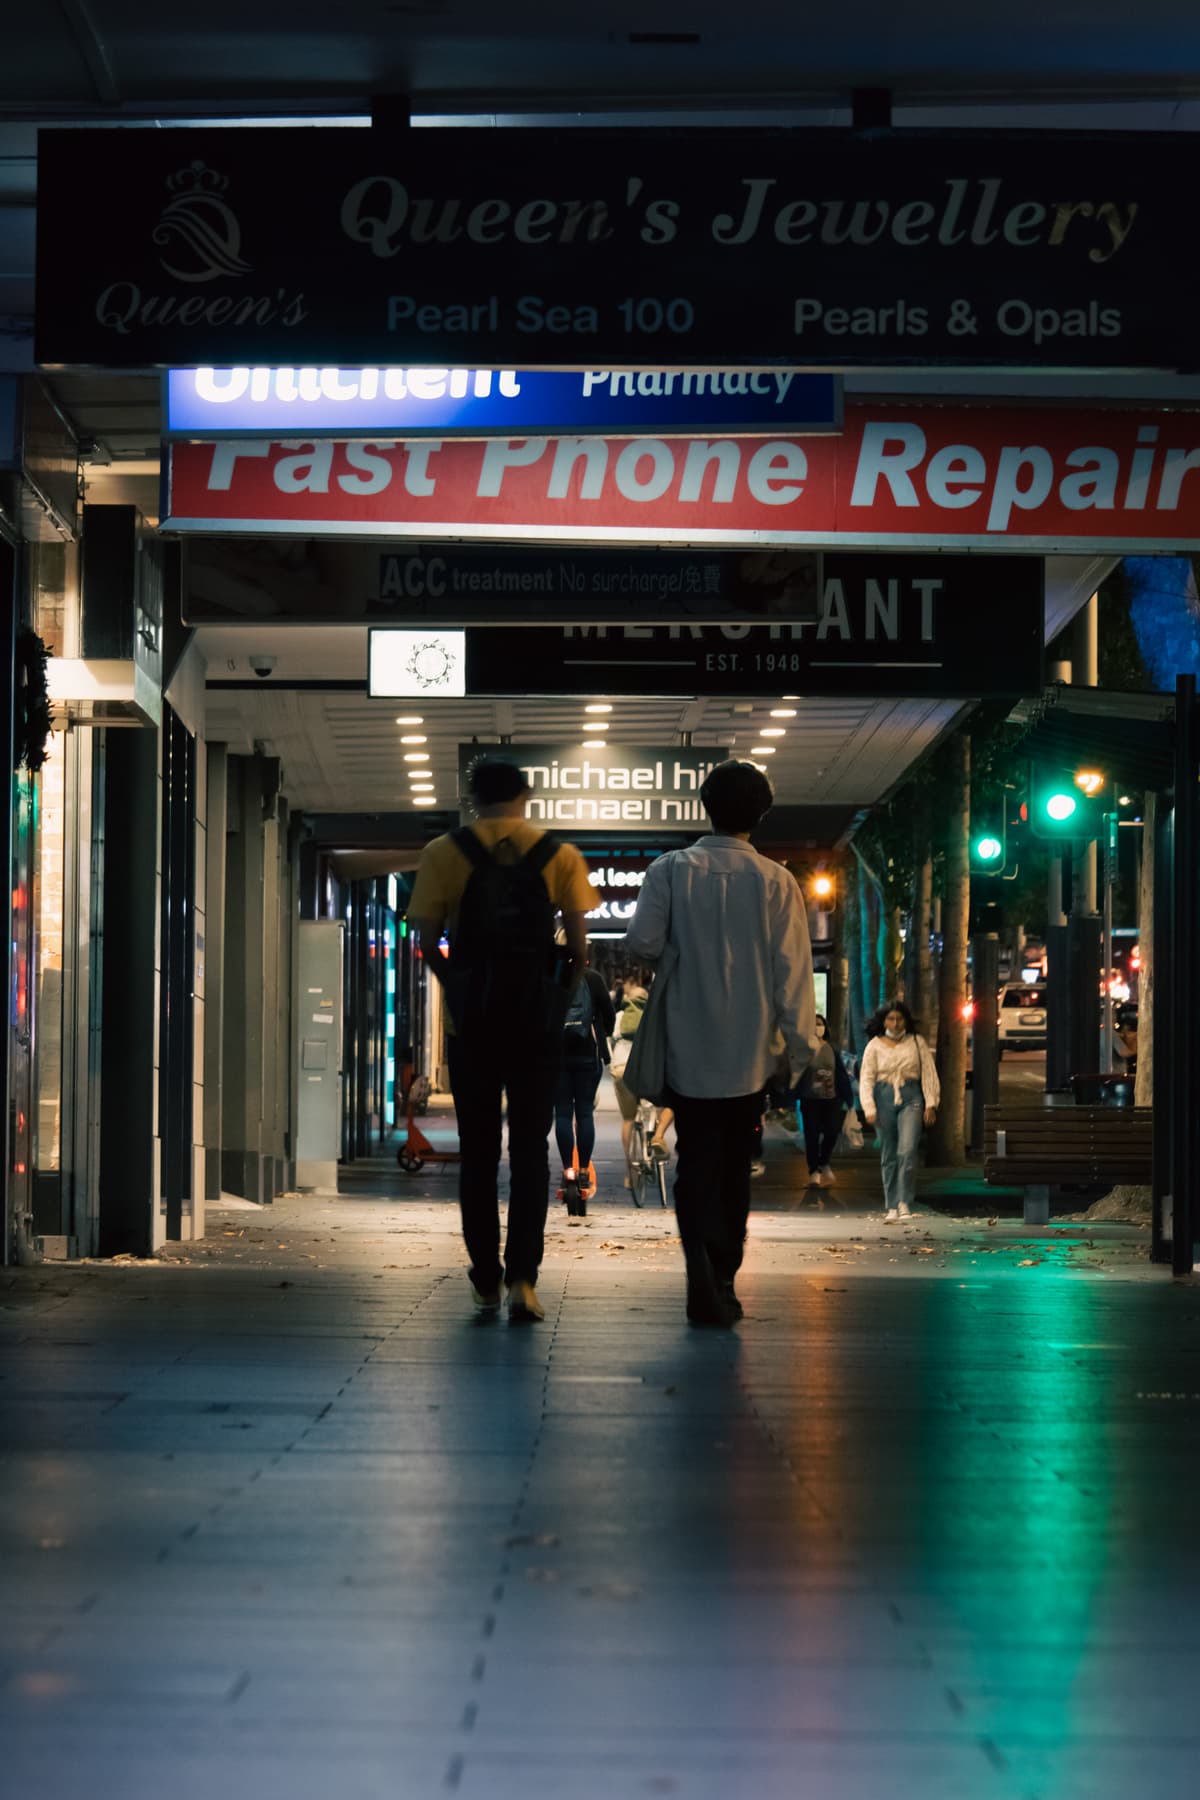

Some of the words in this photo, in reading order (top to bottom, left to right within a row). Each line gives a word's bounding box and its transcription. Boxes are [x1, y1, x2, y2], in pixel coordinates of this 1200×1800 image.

[340, 175, 680, 258] Queen's
[712, 177, 1138, 264] Jewellery
[94, 281, 311, 335] Queen's
[387, 295, 498, 334] Pearl
[516, 296, 599, 334] Sea
[617, 298, 696, 335] 100
[793, 298, 929, 338] Pearls
[946, 299, 979, 337] &
[996, 300, 1123, 345] Opals
[476, 436, 809, 506] Phone
[381, 556, 448, 598] ACC
[452, 567, 555, 592] treatment
[559, 560, 586, 593] No
[705, 653, 744, 672] EST.
[754, 653, 800, 673] 1948
